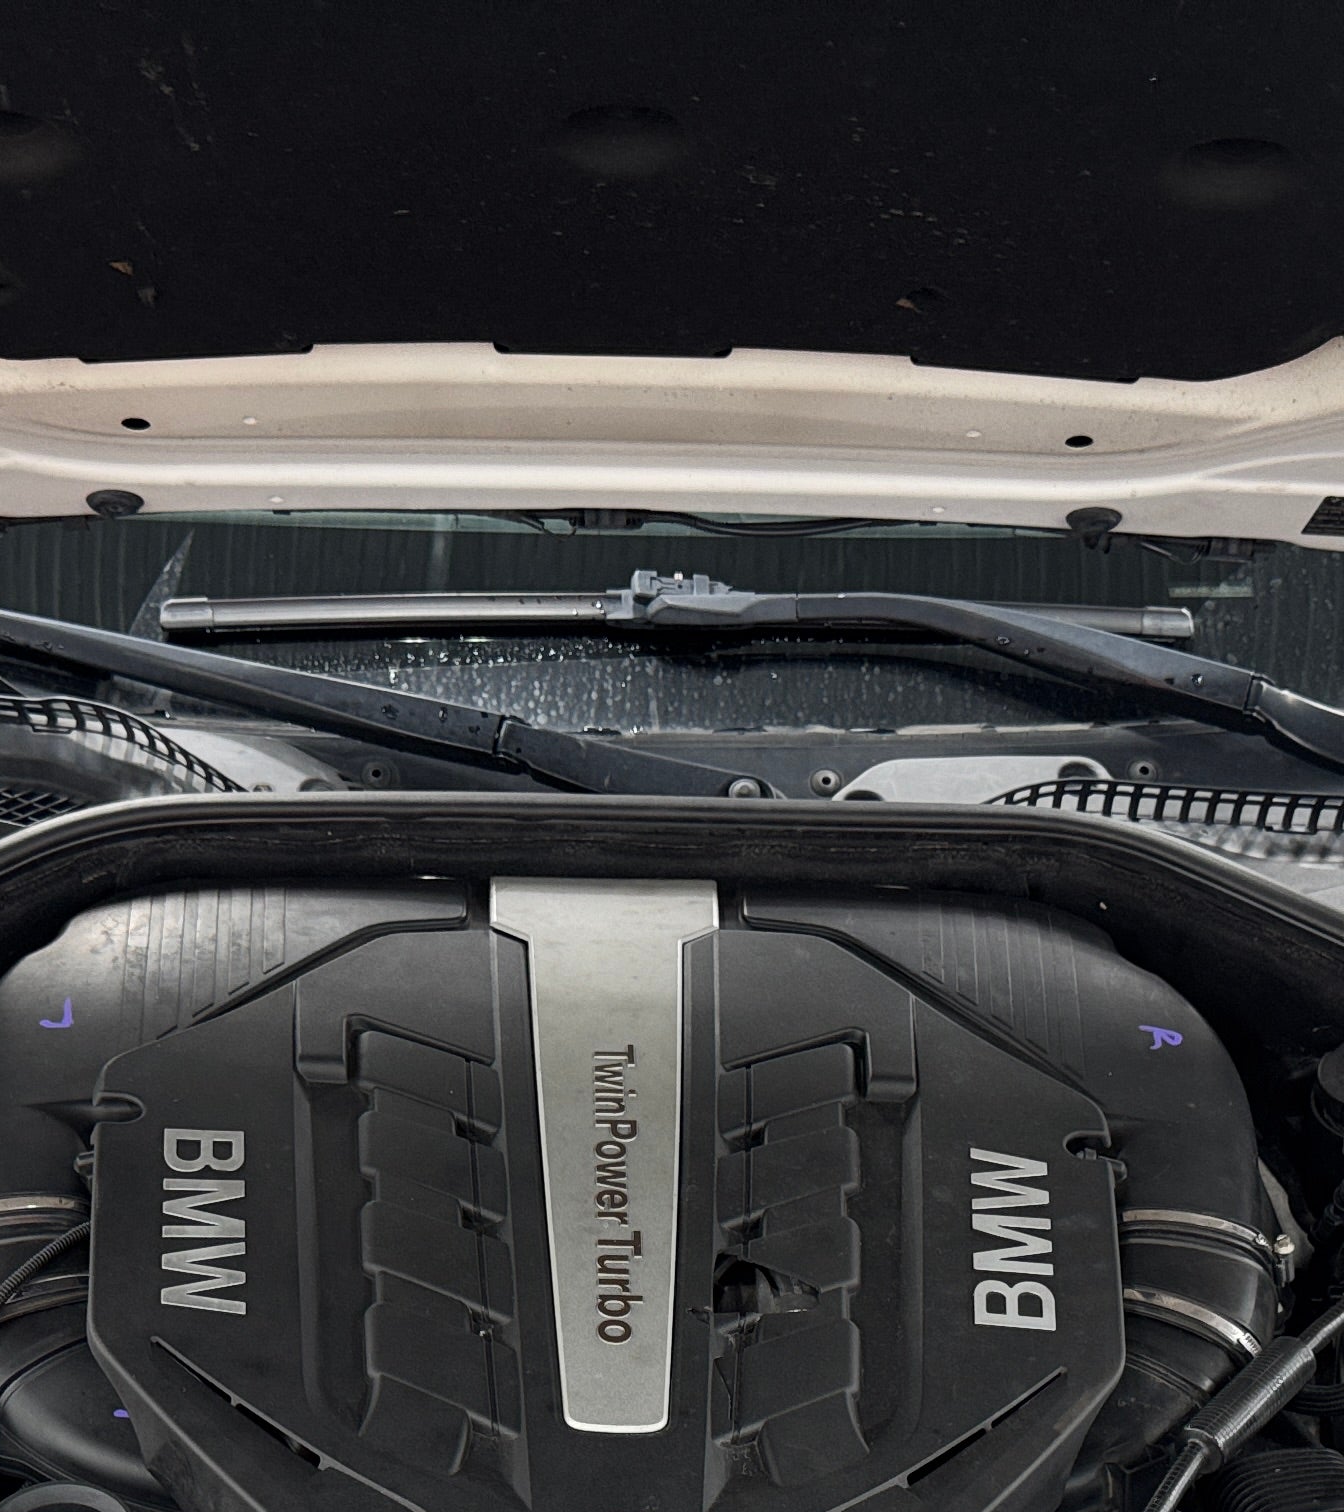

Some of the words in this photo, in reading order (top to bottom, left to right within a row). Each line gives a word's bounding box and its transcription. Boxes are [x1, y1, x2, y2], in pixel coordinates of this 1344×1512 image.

[160, 1127, 246, 1315] BMW
[592, 1044, 638, 1225] TwinPower
[596, 1230, 642, 1346] Turbo
[970, 1147, 1057, 1332] BMW
